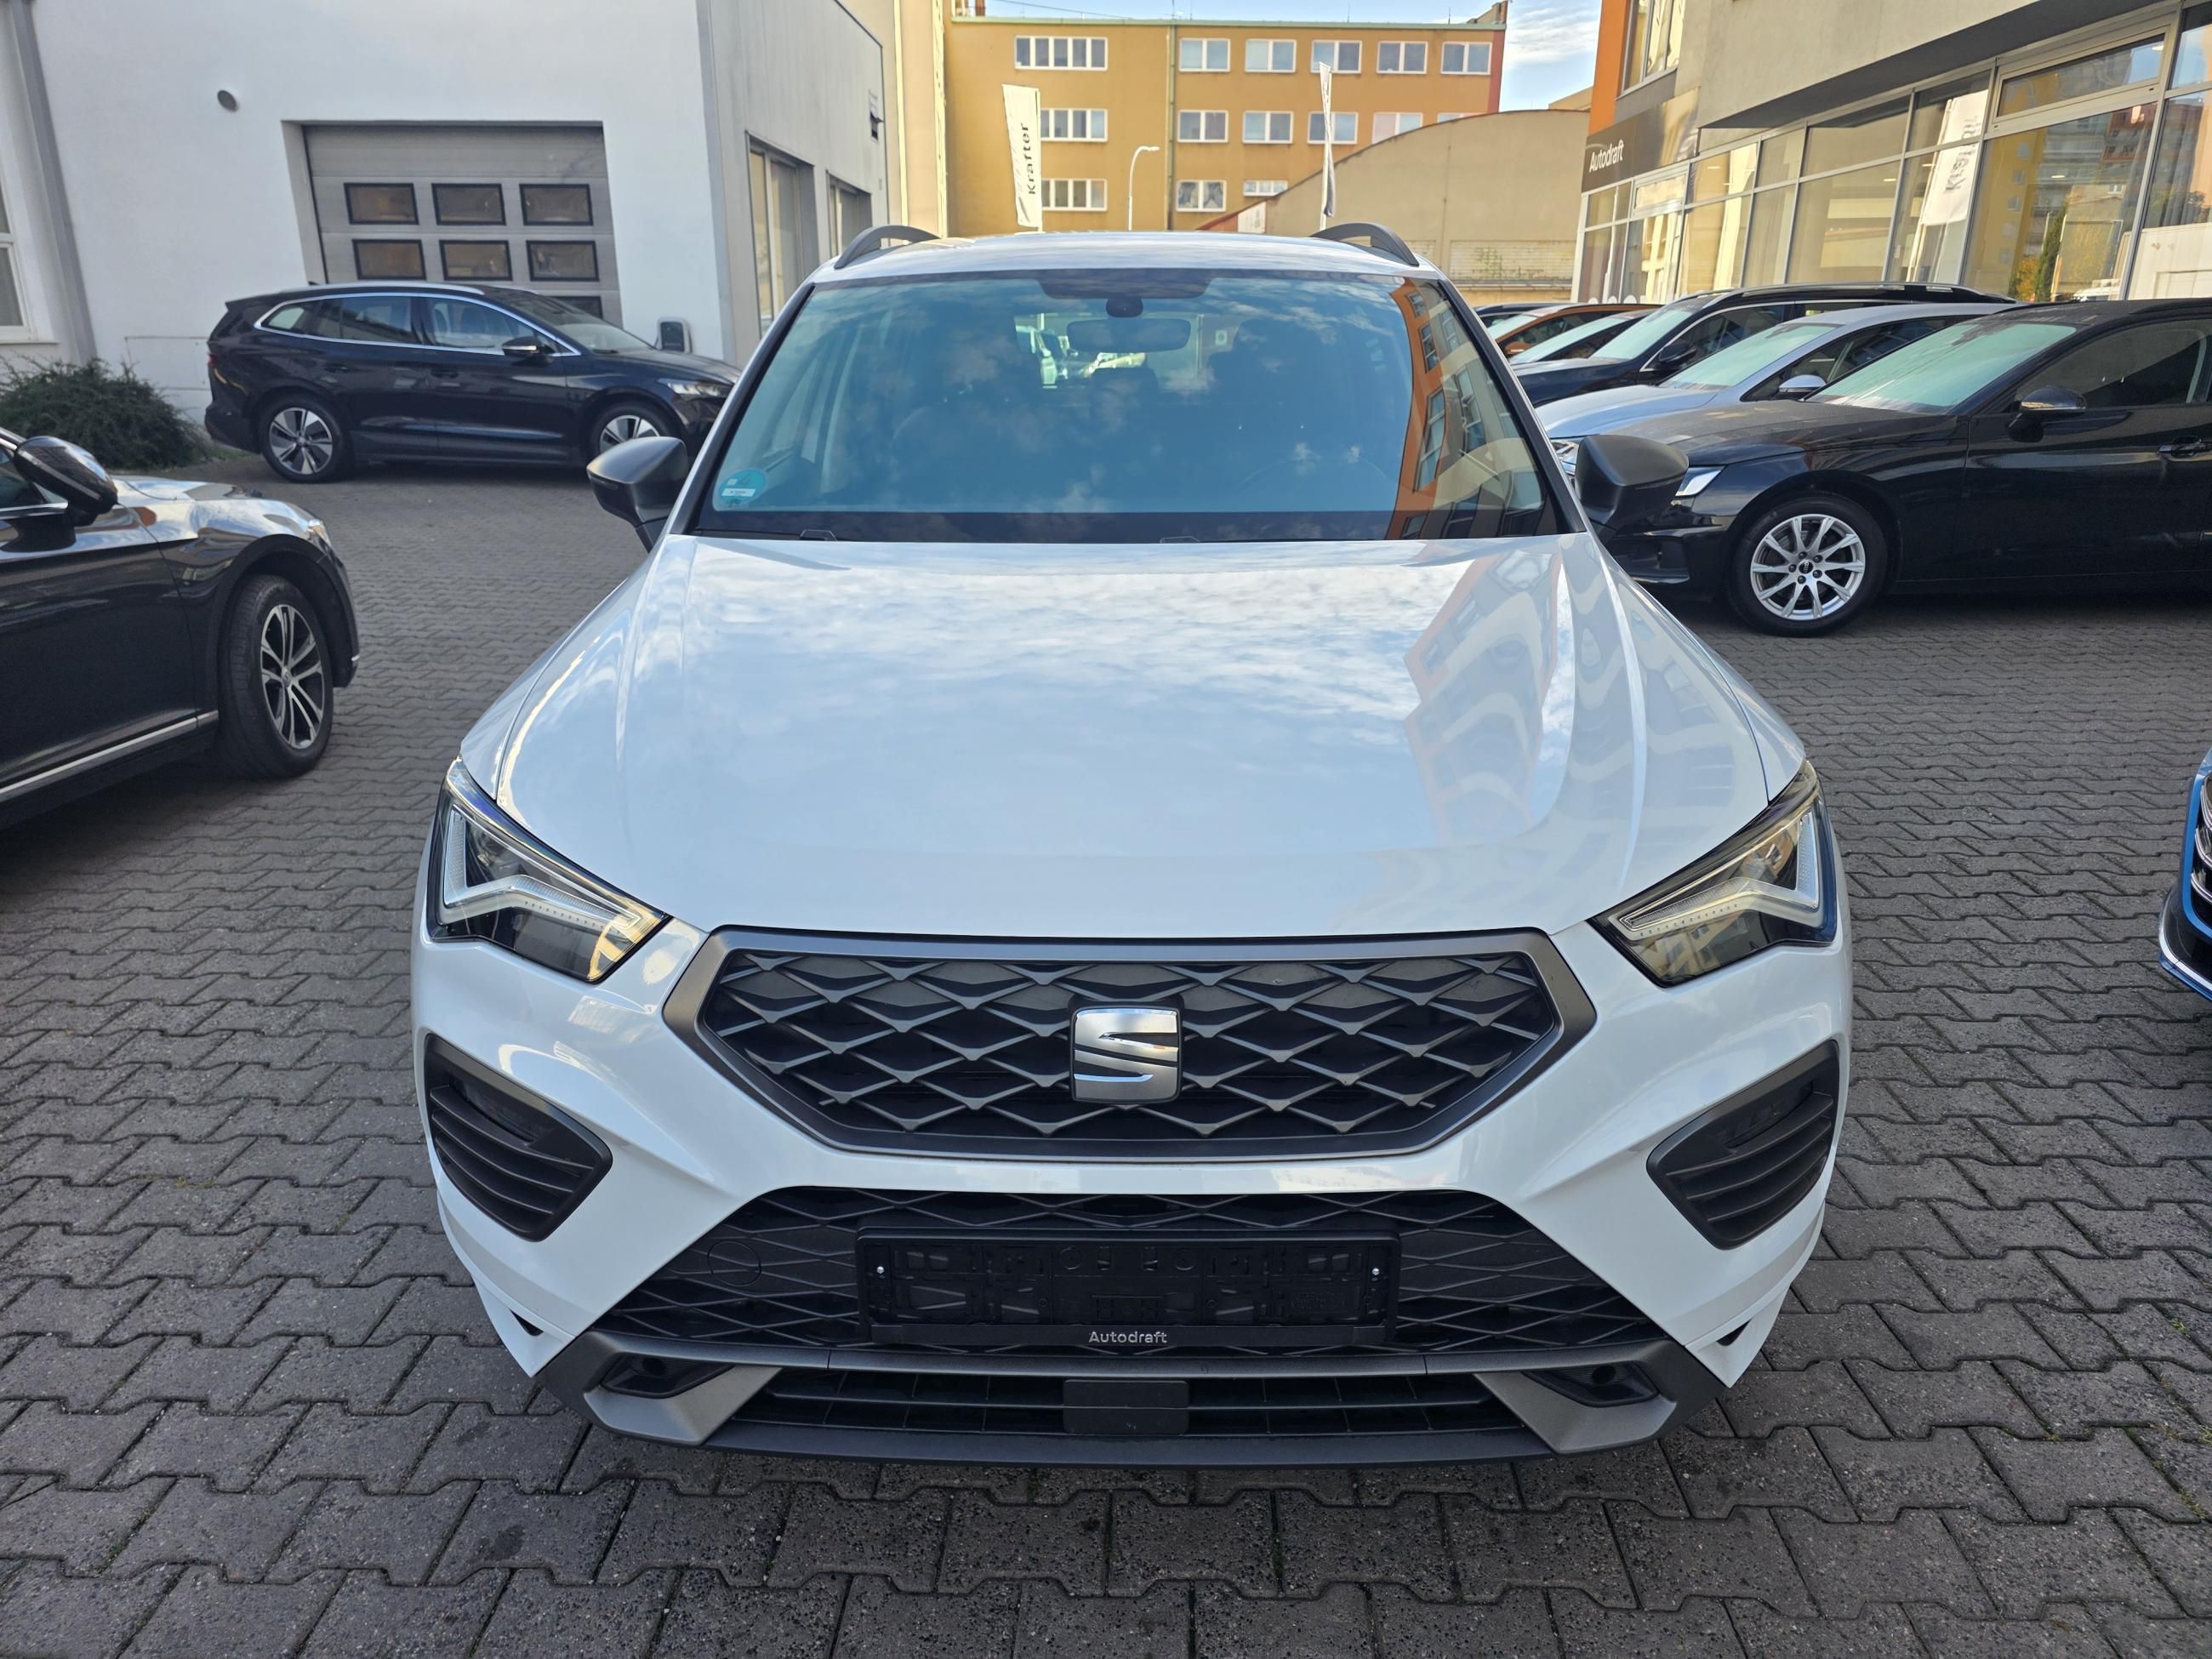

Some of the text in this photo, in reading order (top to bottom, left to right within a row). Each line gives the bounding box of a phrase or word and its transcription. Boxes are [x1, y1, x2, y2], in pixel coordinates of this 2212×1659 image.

[1021, 123, 1036, 195] Krafter
[1588, 139, 1624, 173] Autodraft
[1089, 1331, 1167, 1343] Autodraft
